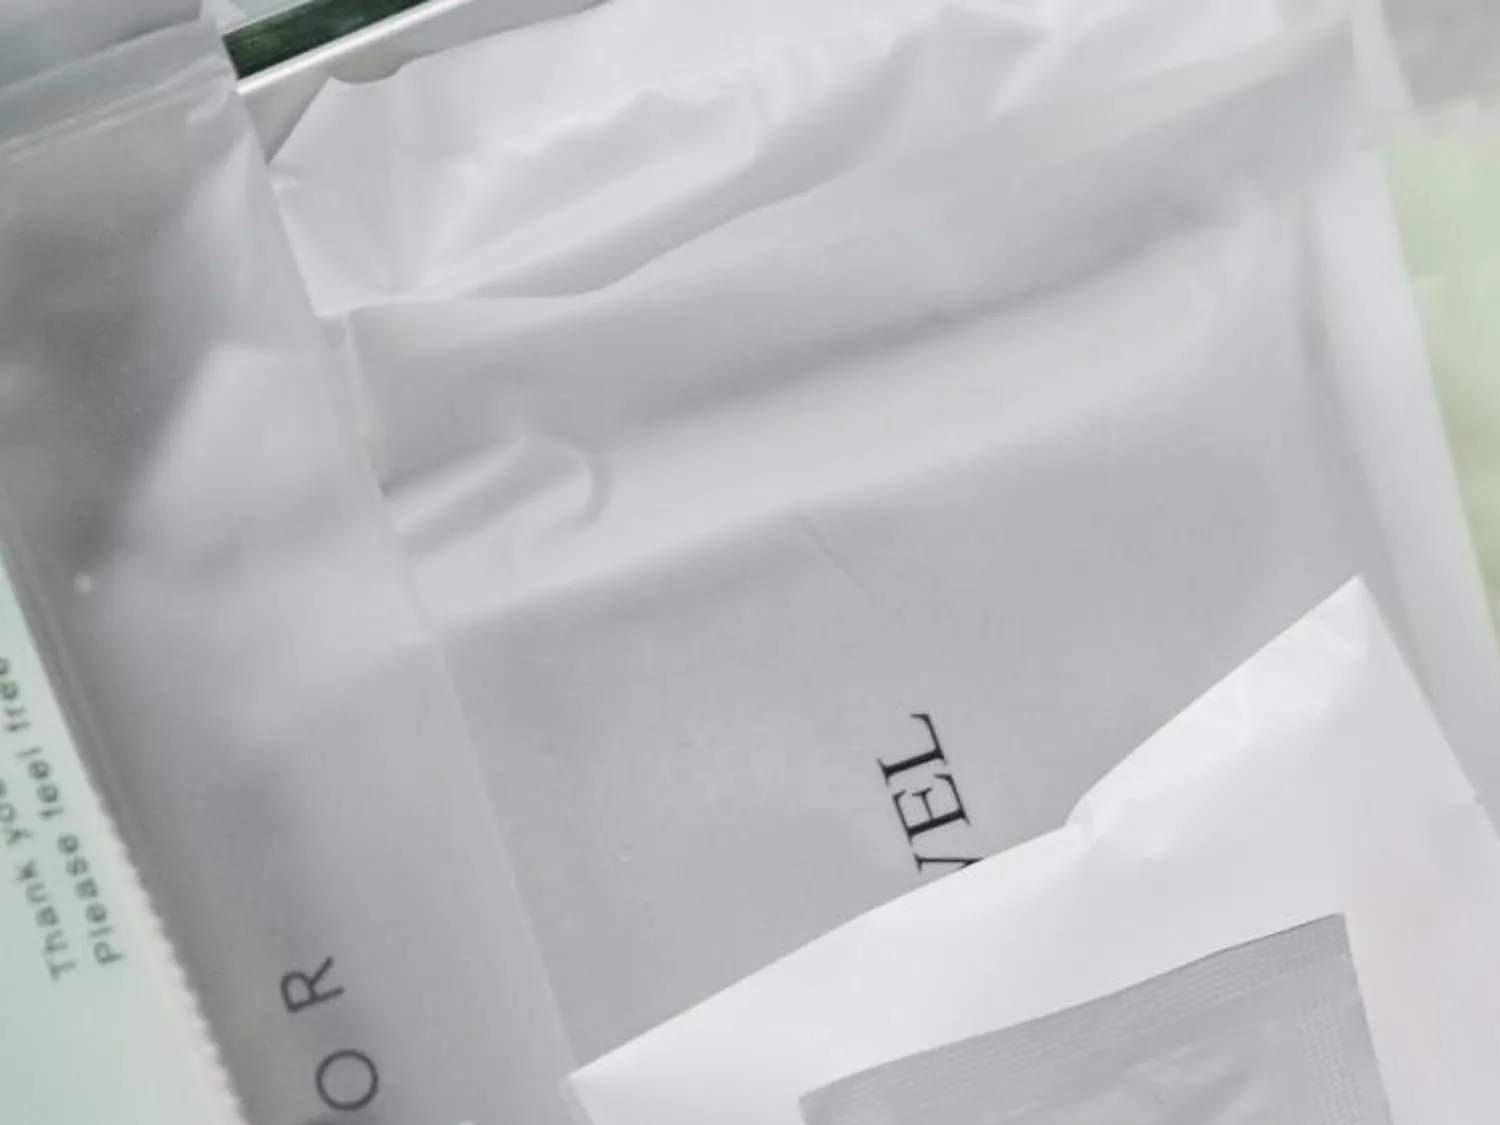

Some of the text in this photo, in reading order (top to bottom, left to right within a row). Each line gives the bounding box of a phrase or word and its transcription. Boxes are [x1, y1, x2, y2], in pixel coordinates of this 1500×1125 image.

[17, 745, 65, 820] feel
[13, 857, 77, 982] Thank
[57, 832, 125, 967] Please
